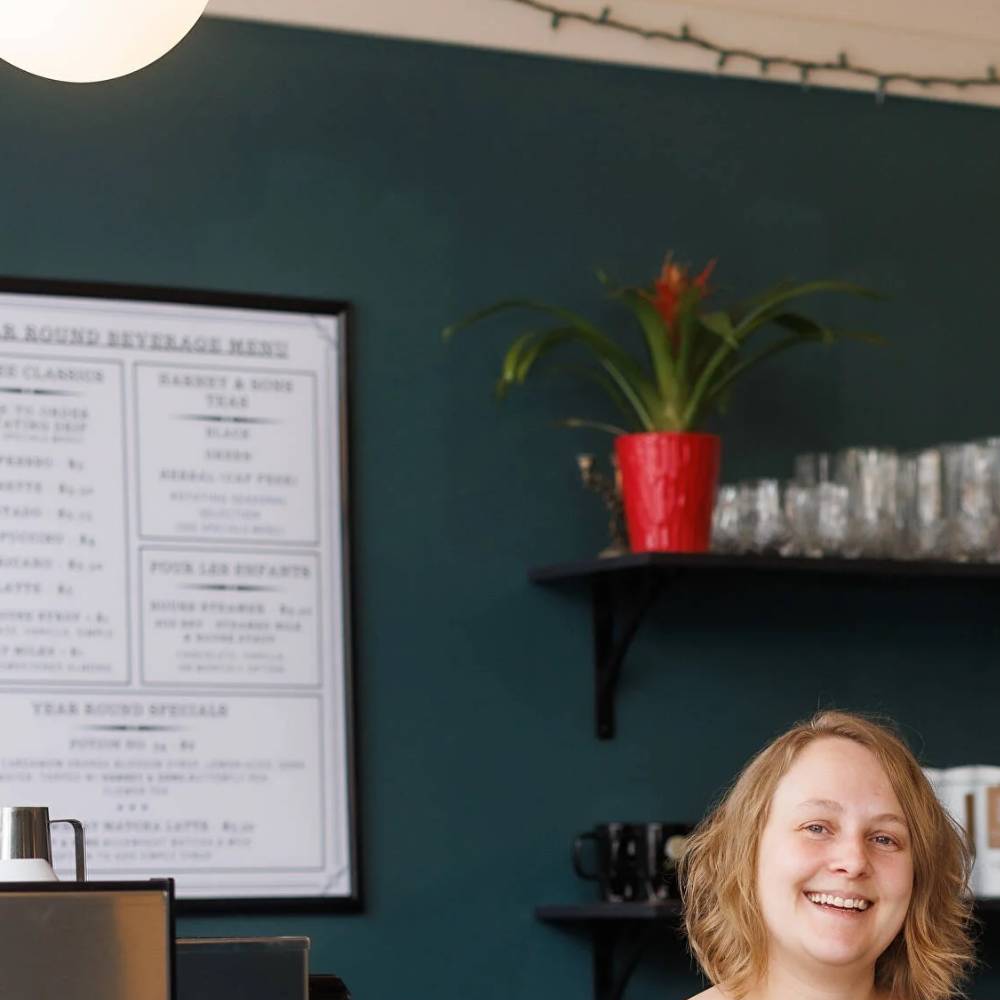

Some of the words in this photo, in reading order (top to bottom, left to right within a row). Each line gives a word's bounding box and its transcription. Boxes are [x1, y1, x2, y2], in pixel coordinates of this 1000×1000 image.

[24, 324, 101, 347] ROUND
[108, 330, 222, 355] BEVERAGE
[229, 338, 289, 359] MENU
